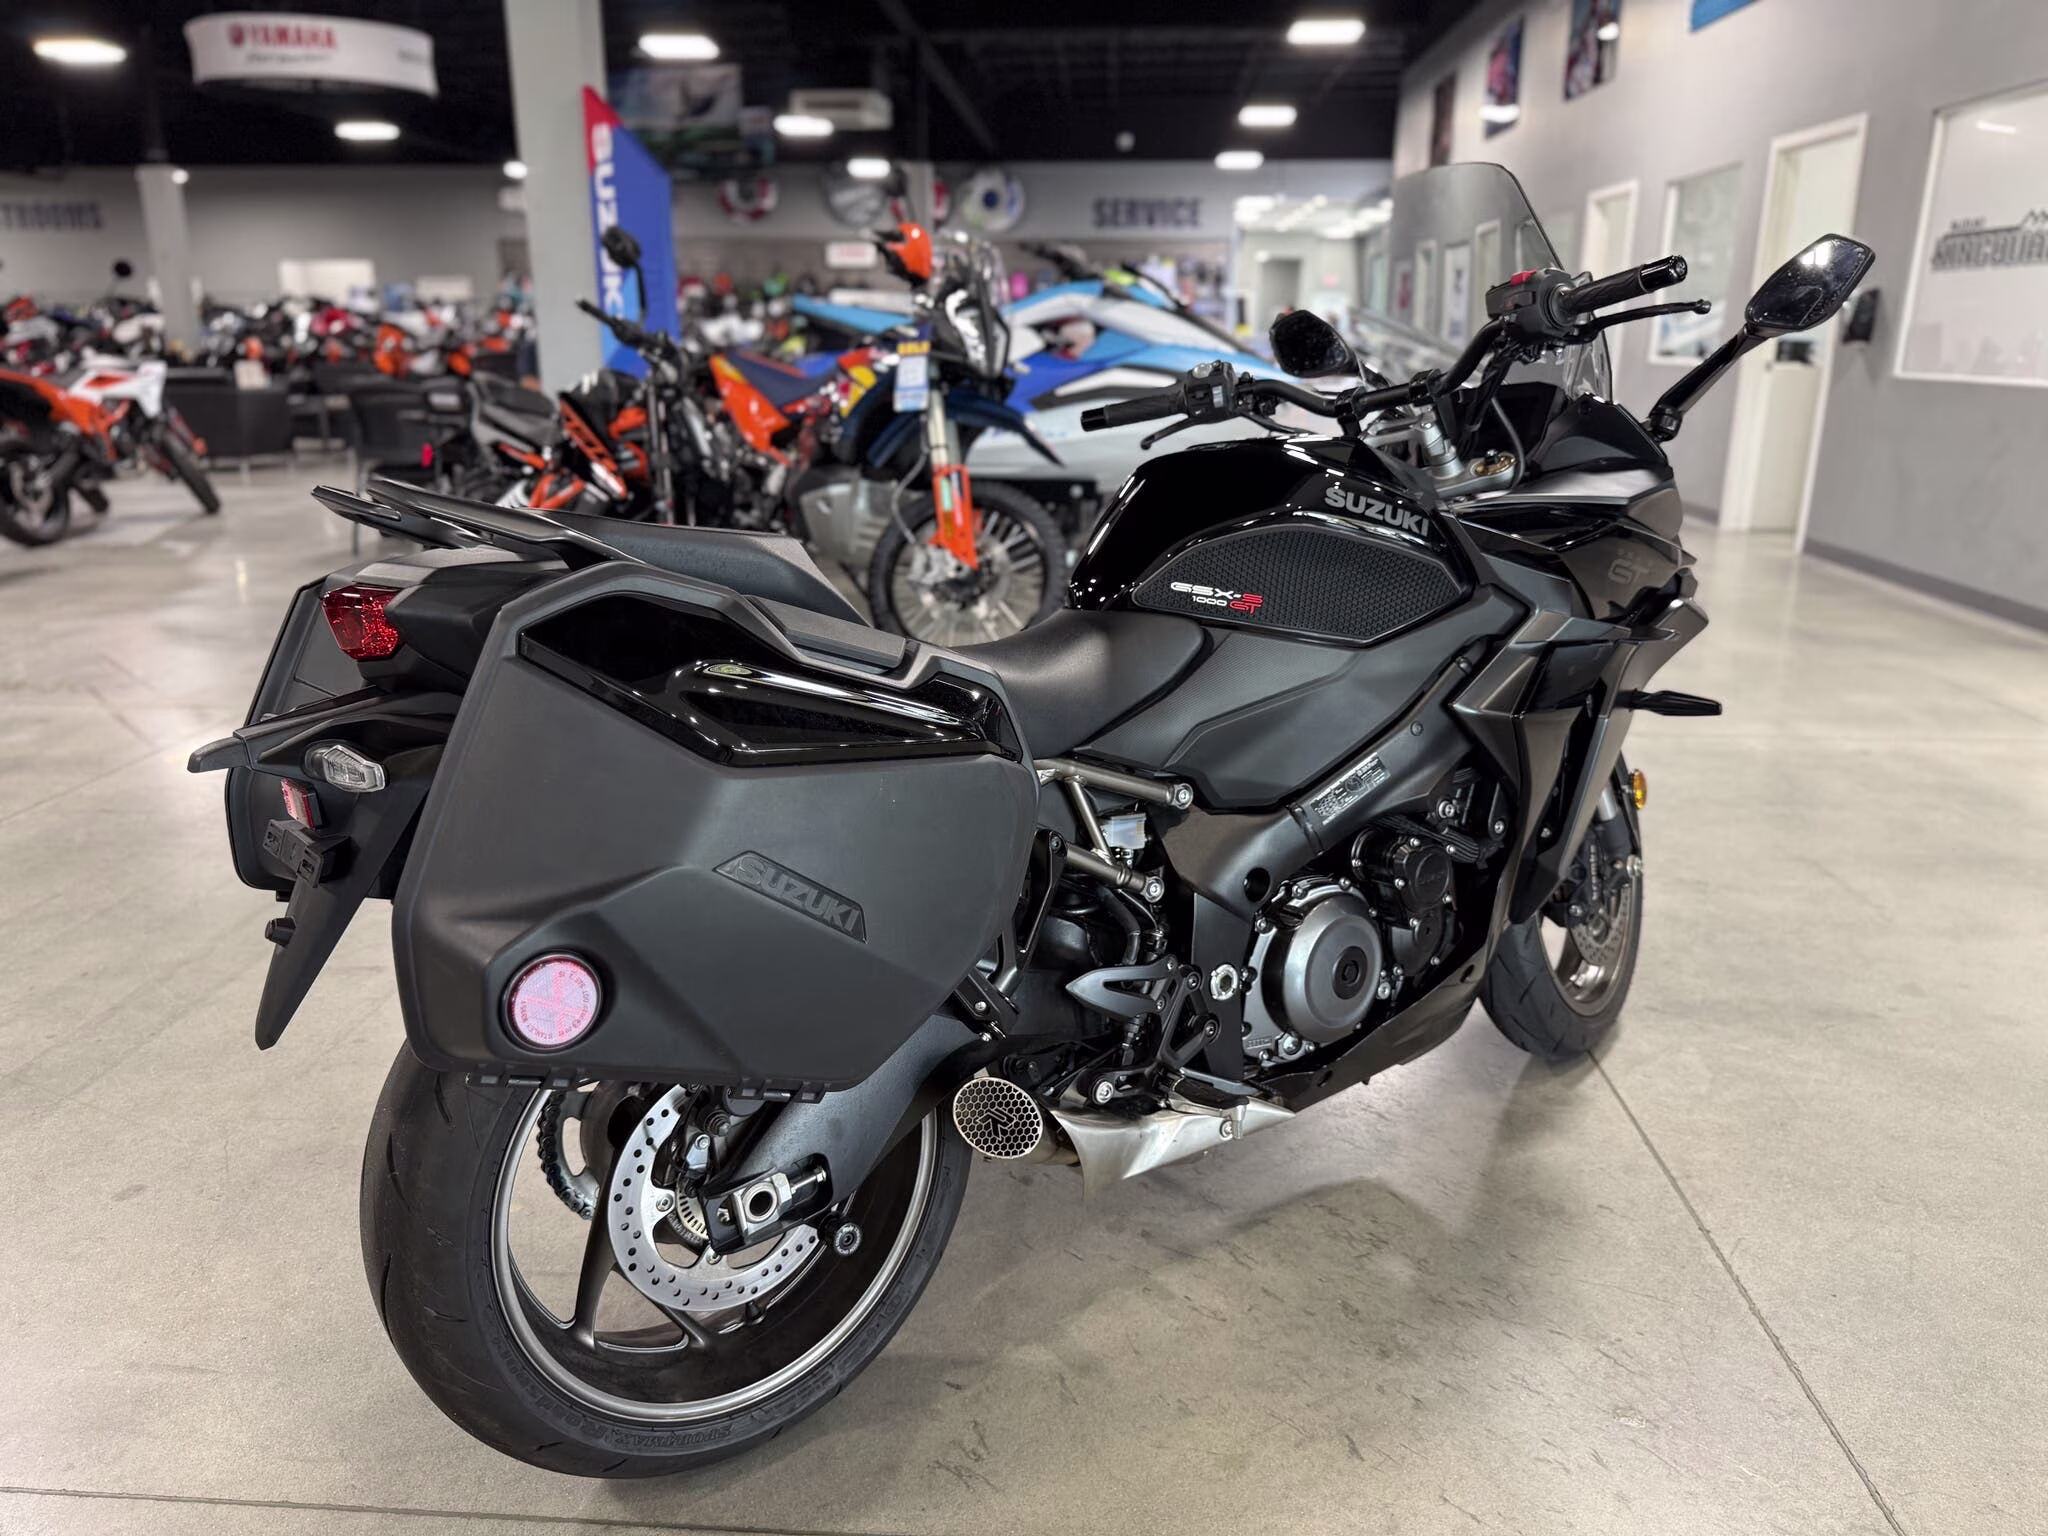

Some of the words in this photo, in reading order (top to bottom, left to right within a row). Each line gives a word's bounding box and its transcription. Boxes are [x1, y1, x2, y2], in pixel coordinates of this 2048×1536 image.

[252, 25, 336, 50] YAMAHA
[592, 123, 624, 320] SUZK
[1093, 198, 1200, 230] SERVICE
[1325, 487, 1429, 537] SUZUKI
[1171, 582, 1263, 603] GSX-S
[1192, 595, 1227, 607] 1000
[1229, 600, 1261, 614] GT
[736, 856, 861, 931] SUZUKI
